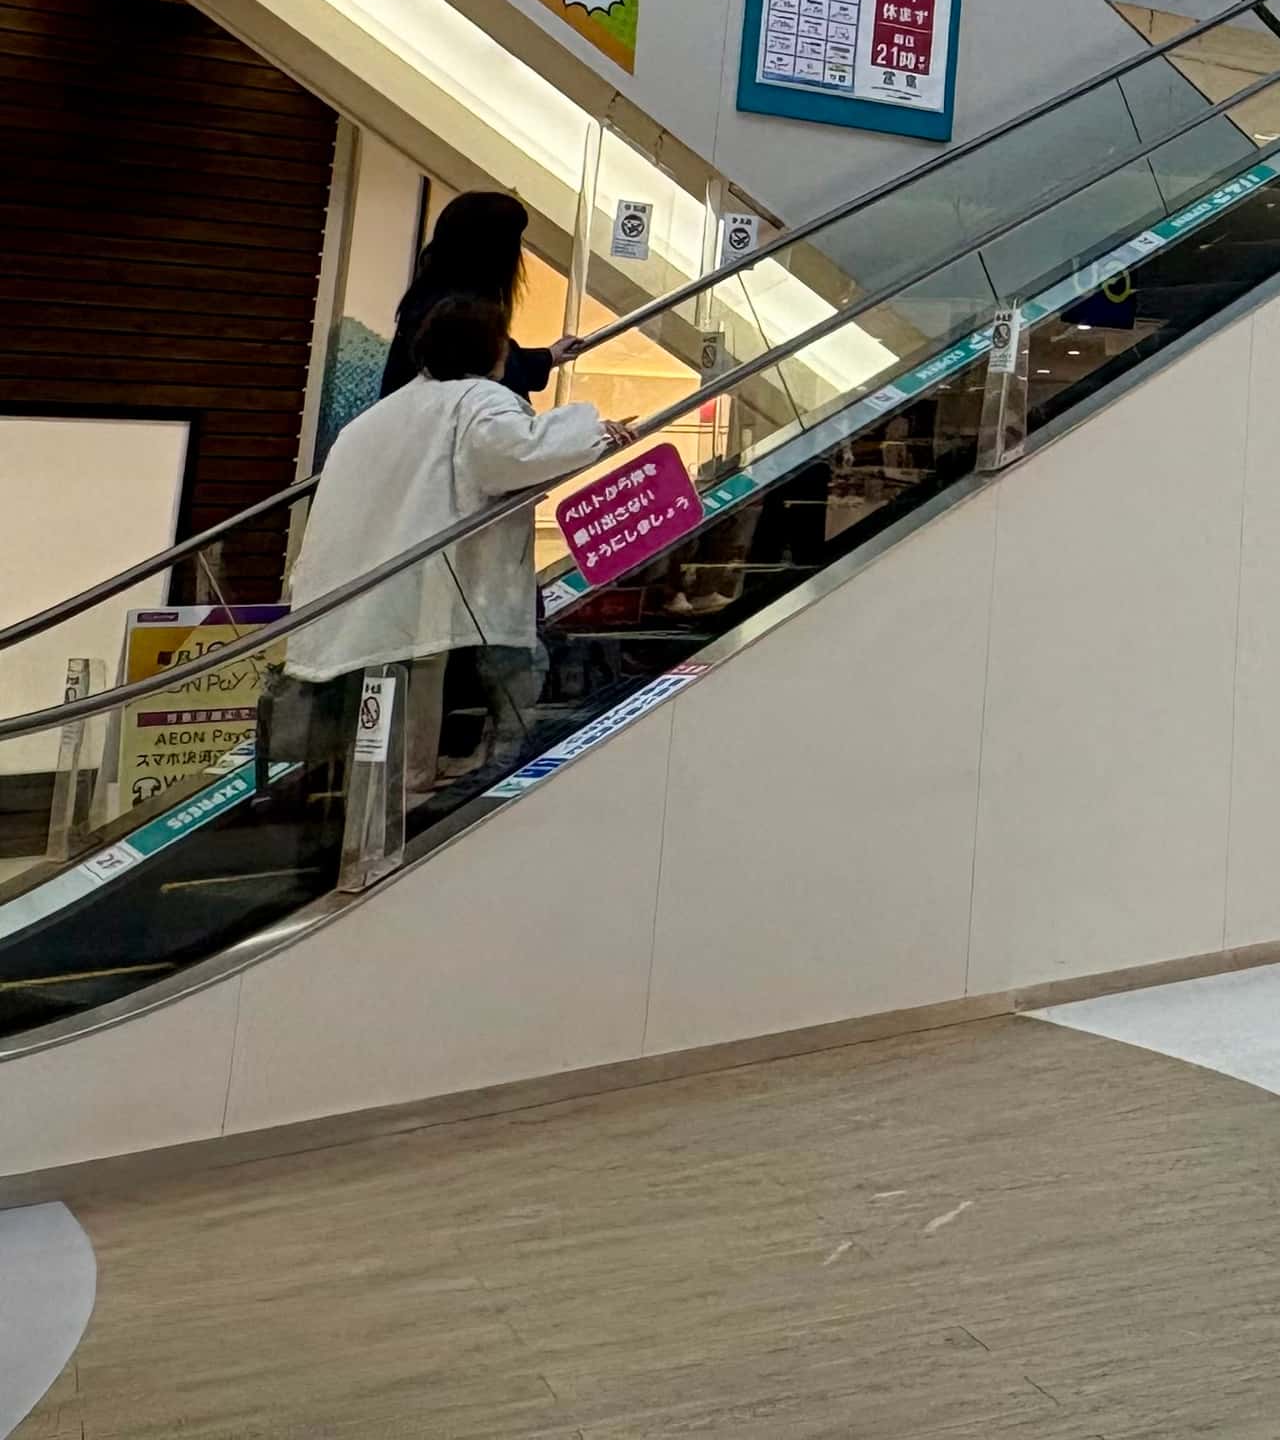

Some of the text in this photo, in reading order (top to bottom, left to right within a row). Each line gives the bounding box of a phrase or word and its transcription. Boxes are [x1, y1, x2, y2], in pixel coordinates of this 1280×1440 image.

[585, 495, 690, 568] ようにしましょう
[155, 731, 205, 746] AEON
